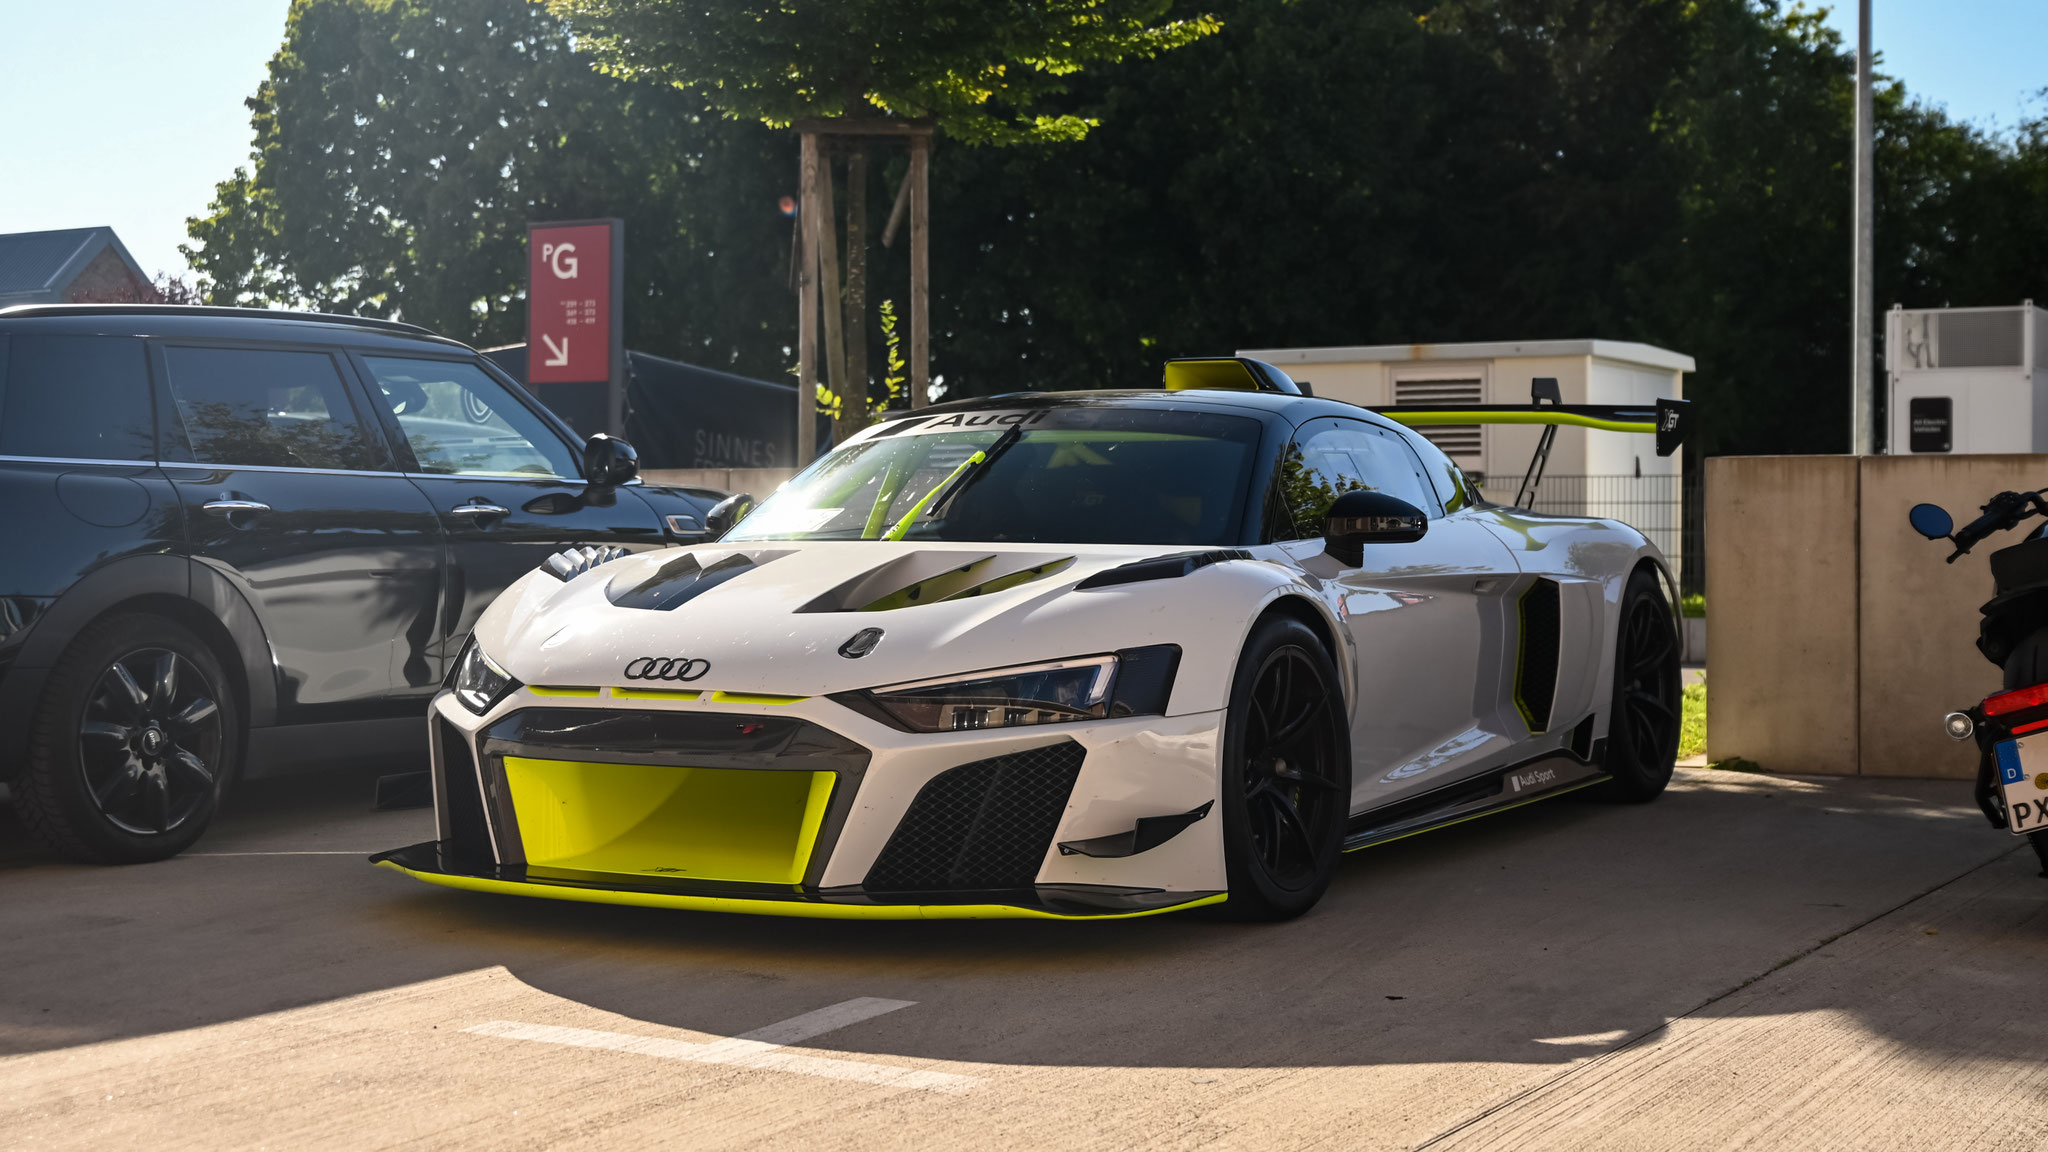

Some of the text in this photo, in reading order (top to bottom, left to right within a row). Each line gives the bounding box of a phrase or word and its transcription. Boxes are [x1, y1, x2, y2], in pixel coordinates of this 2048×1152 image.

[927, 410, 1052, 429] Audi
[695, 428, 777, 468] SINNES
[1519, 769, 1556, 787] Audi Sport
[2007, 768, 2017, 779] D
